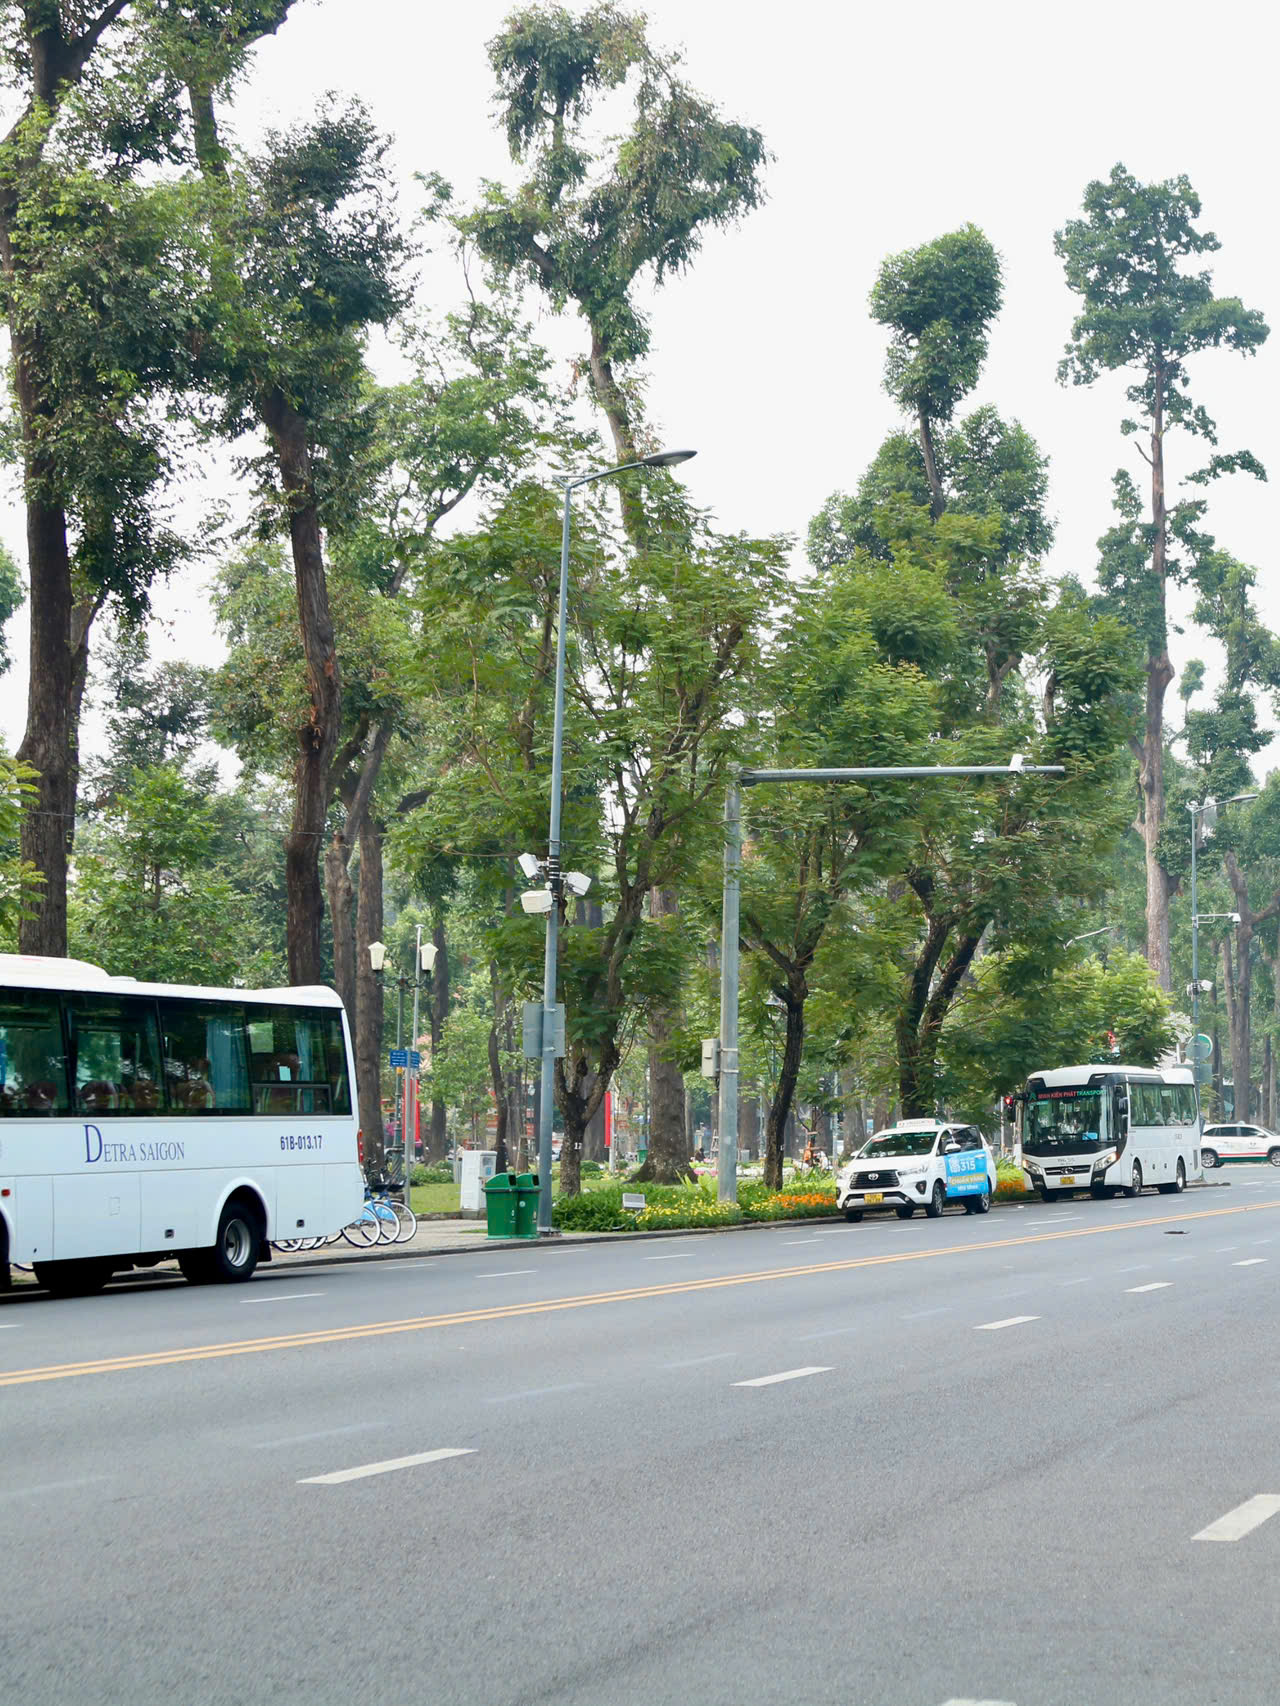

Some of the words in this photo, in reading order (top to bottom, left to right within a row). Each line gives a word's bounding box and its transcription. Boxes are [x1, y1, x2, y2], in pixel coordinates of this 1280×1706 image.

[83, 1124, 137, 1164] DETRA
[139, 1141, 185, 1161] SAIGON
[280, 1135, 322, 1151] 61B-013.17
[960, 1159, 976, 1171] 315
